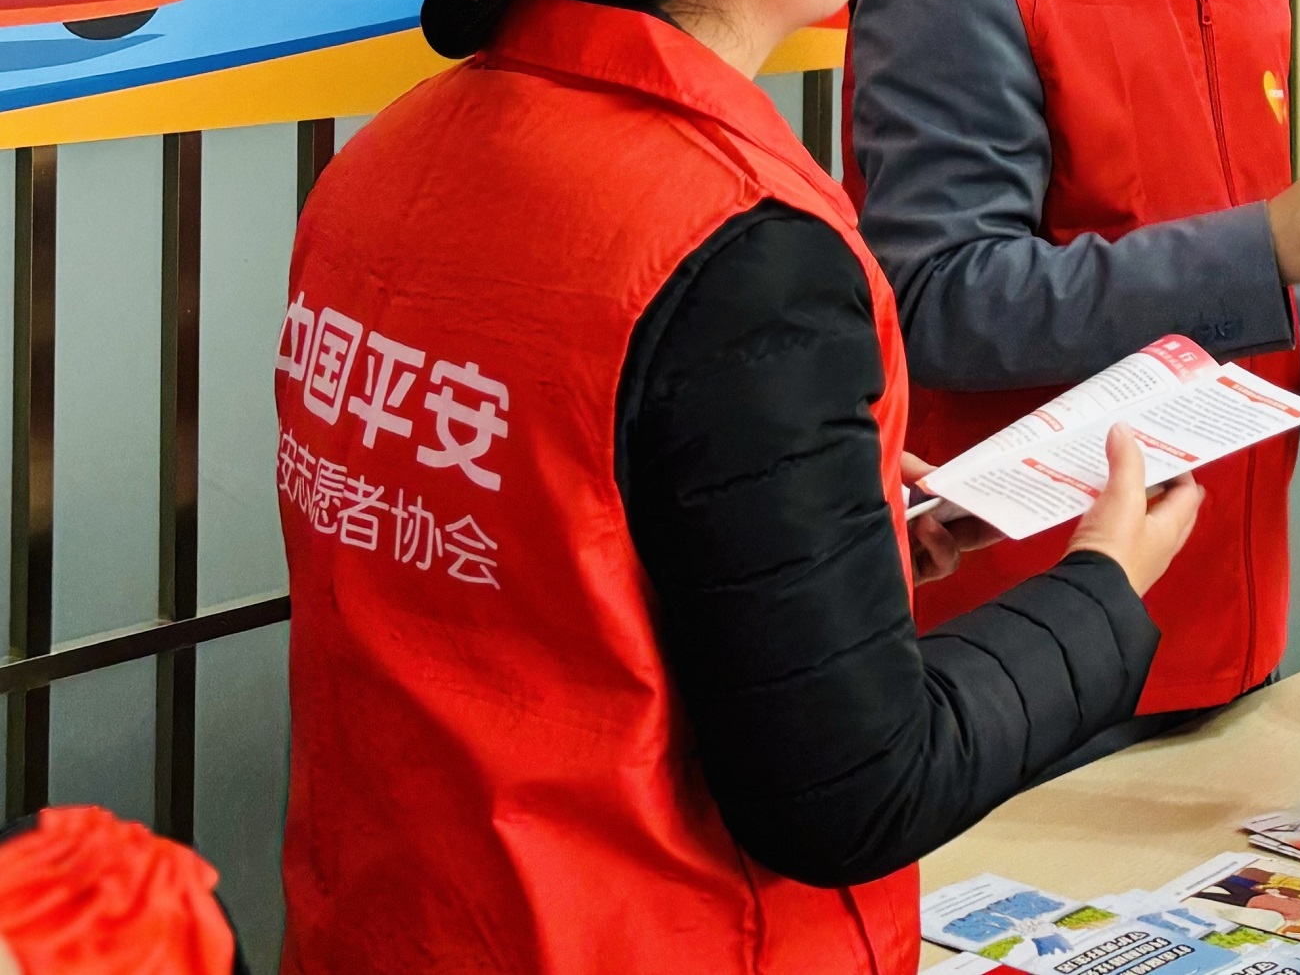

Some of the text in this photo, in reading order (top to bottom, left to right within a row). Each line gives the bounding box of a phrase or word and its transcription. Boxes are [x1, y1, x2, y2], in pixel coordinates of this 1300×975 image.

[275, 290, 510, 492] 中国平安
[276, 425, 501, 591] 安志愿者协会
